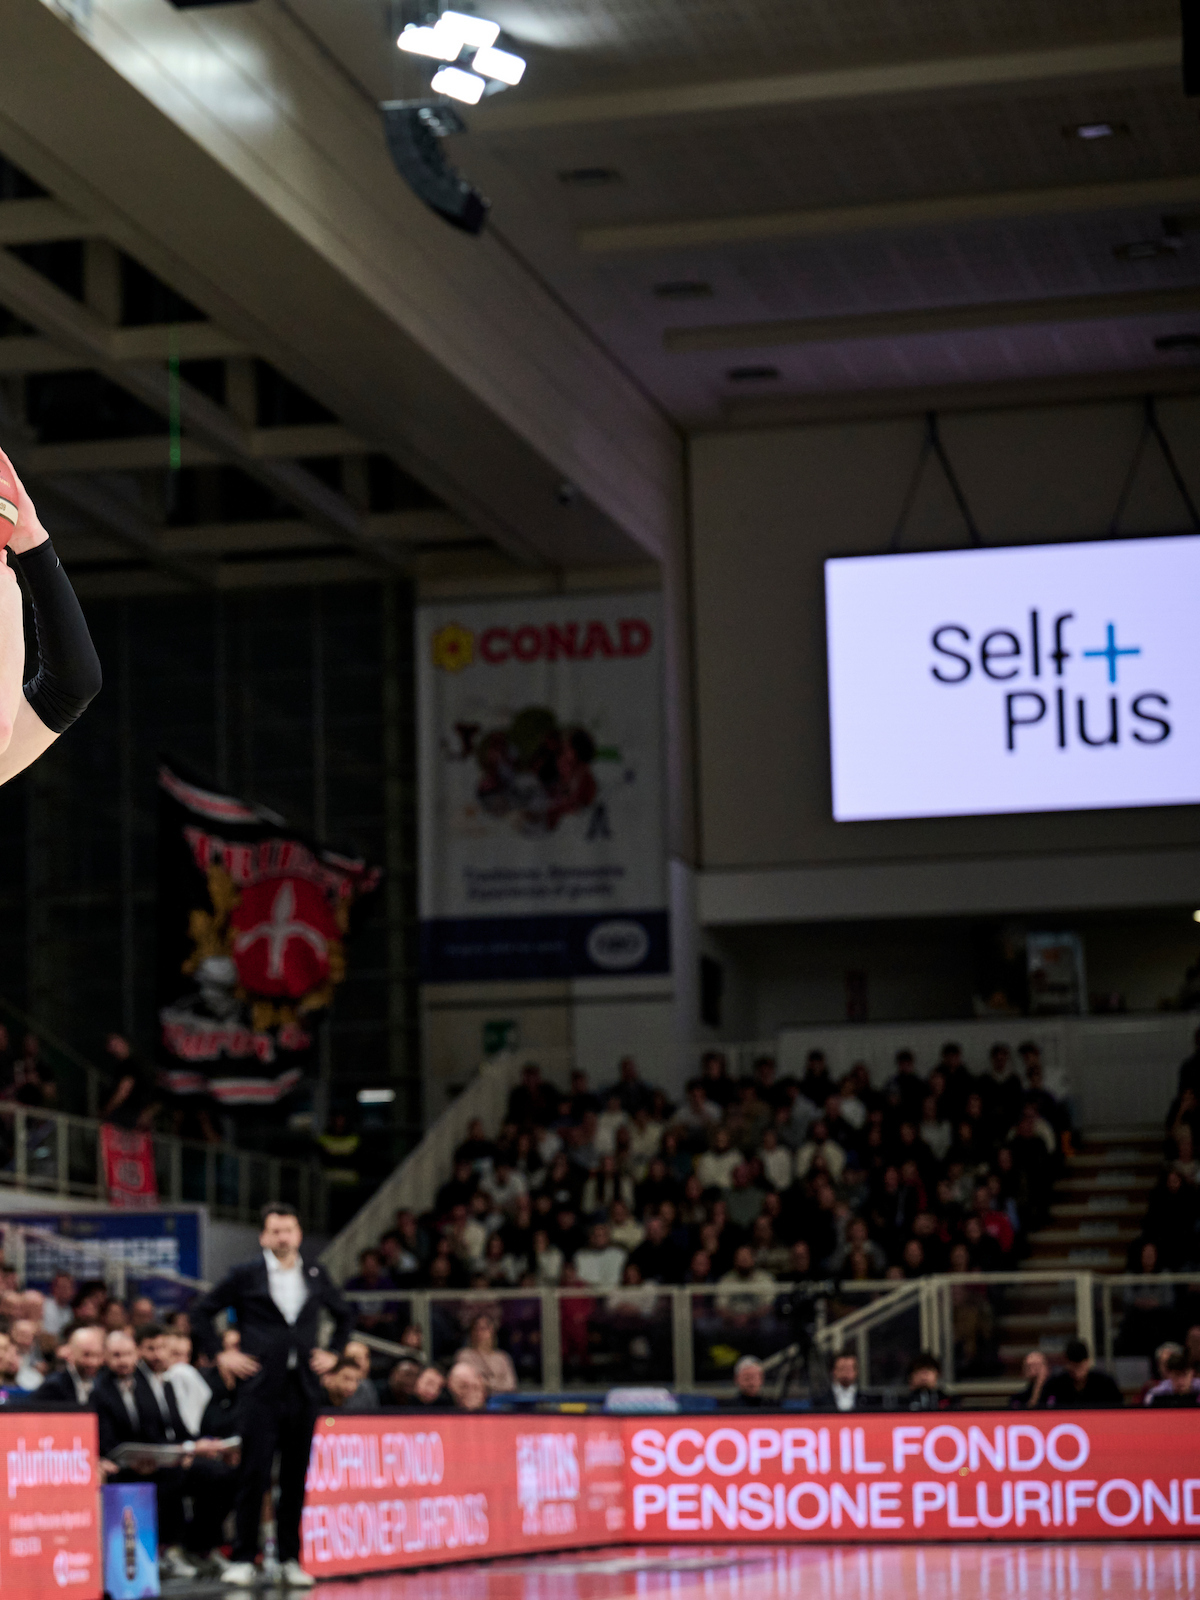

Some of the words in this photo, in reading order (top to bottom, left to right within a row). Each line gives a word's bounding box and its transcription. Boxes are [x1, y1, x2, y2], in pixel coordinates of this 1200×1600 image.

[481, 619, 651, 662] CONAD
[1004, 687, 1171, 752] Plus
[630, 1427, 831, 1477] SCOPRI
[839, 1426, 886, 1474] IL
[892, 1423, 1090, 1474] FONDO
[633, 1481, 904, 1531] PENSIONE
